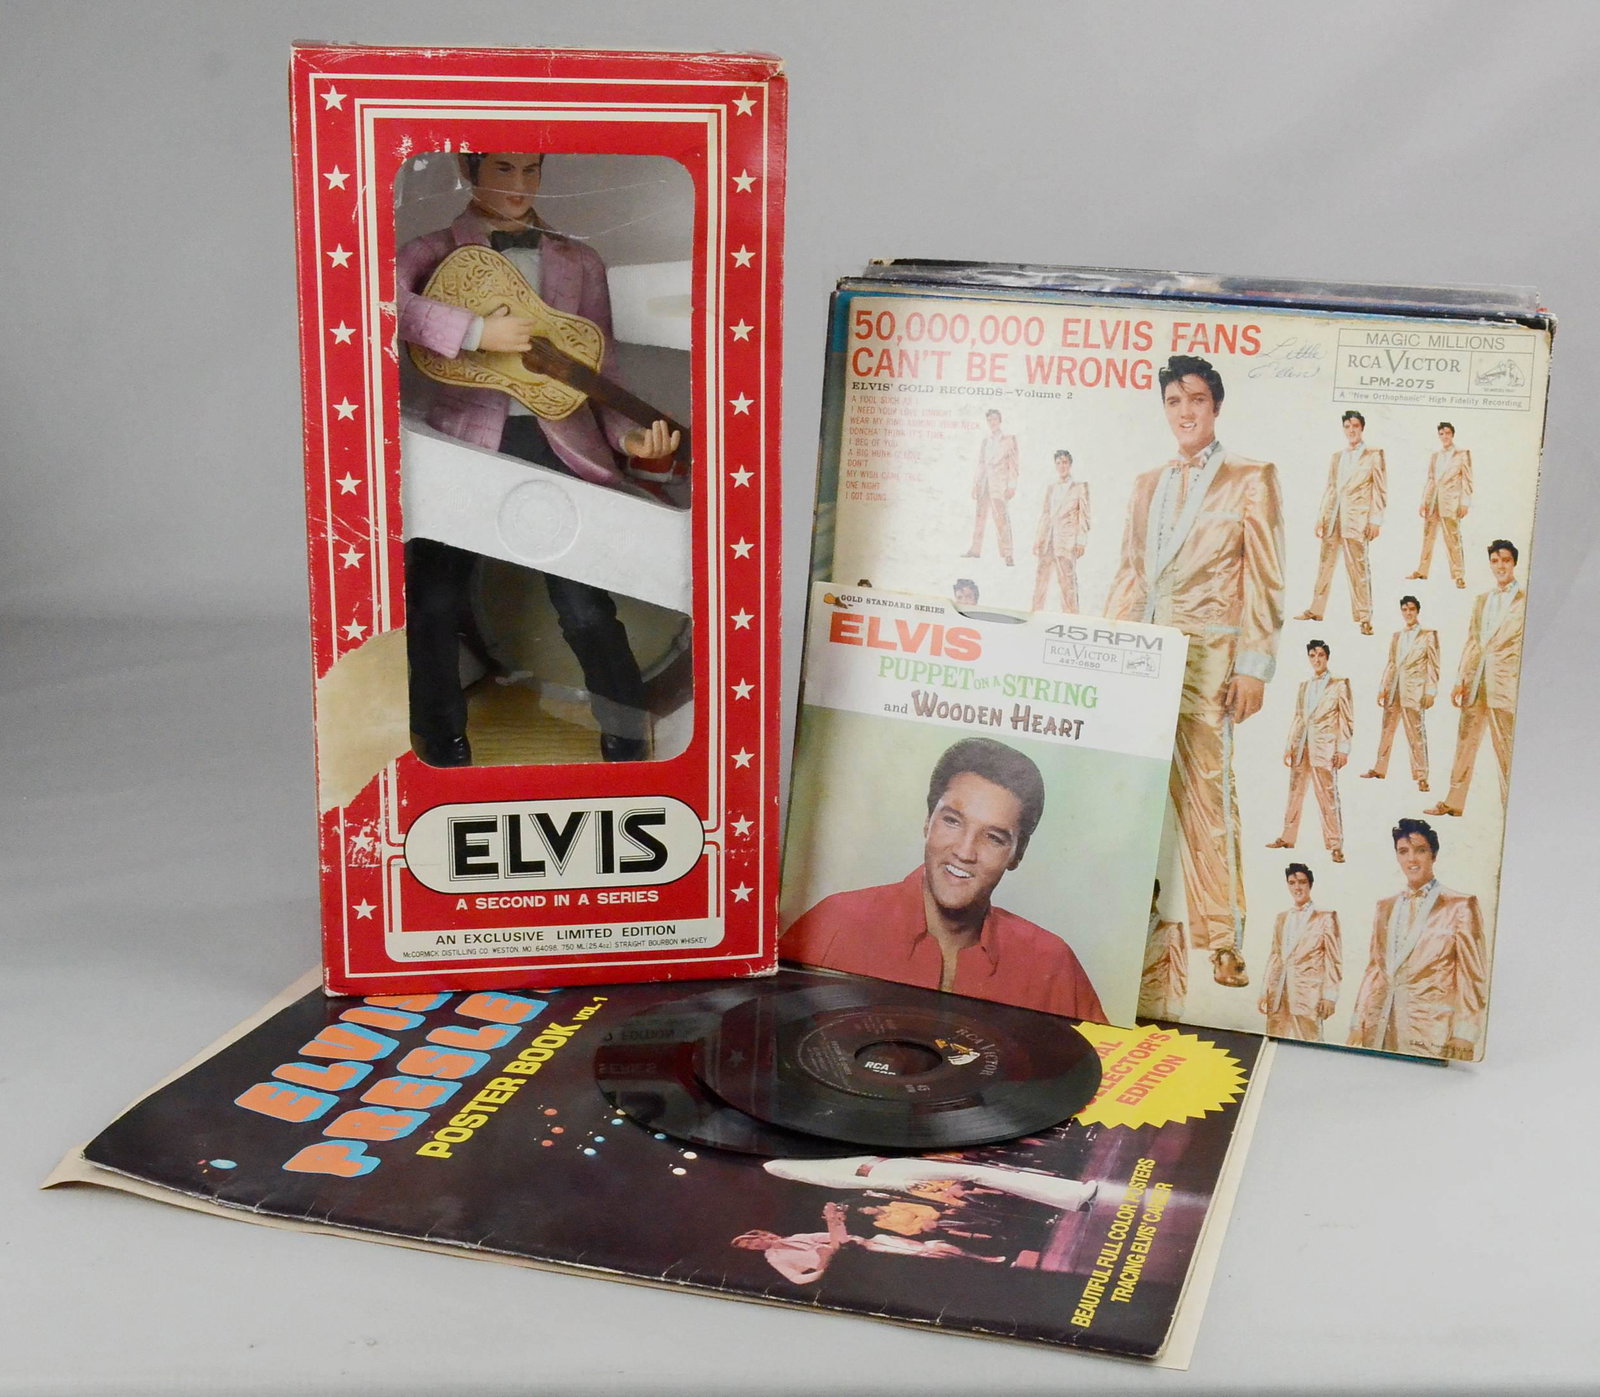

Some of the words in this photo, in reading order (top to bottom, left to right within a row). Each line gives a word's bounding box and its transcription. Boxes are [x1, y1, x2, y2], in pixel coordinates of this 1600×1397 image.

[854, 310, 1044, 347] 50,000,000
[1061, 318, 1154, 351] ELVIS
[1170, 322, 1262, 356] FANS
[1366, 332, 1420, 347] MAGIC
[1428, 334, 1505, 350] MILLIONS
[852, 347, 954, 380] CAN'T
[966, 351, 1008, 383] BE
[1025, 354, 1153, 390] WRONG
[1348, 354, 1381, 369] RCA
[1383, 349, 1462, 374] VICTOR
[852, 382, 894, 392] ELVIS'
[898, 383, 934, 393] GOLD
[1360, 376, 1434, 390] LPM-2075
[857, 406, 875, 414] NEED
[1429, 396, 1447, 404] High
[1450, 397, 1479, 406] Fidelity
[1483, 398, 1522, 408] Recording
[873, 417, 882, 425] MY
[855, 438, 869, 446] BEG
[847, 459, 868, 467] DON'T
[856, 449, 868, 457] BIG
[871, 450, 891, 458] HUNK
[847, 469, 857, 477] MY
[860, 470, 878, 478] WISH
[846, 481, 858, 489] ONE
[862, 482, 880, 490] NIGHT
[851, 492, 863, 500] GOT
[840, 594, 863, 603] GOLD
[866, 597, 912, 609] STANDARD
[914, 604, 945, 614] SERIES
[829, 611, 982, 662] ELVIS
[1045, 624, 1088, 641] 45
[1093, 629, 1163, 651] RPM
[1050, 646, 1071, 656] RCA
[1073, 645, 1118, 663] VICTOR
[878, 655, 975, 690] PUPPET
[974, 676, 989, 690] ON
[990, 676, 1000, 687] A
[1002, 673, 1099, 709] STRING
[884, 702, 908, 714] and
[911, 689, 1003, 727] WOODEN
[1010, 703, 1085, 740] HEART
[447, 807, 669, 882] ELVIS
[456, 898, 468, 911] A
[475, 895, 546, 910] SECOND
[553, 894, 570, 906] IN
[577, 893, 590, 906] A
[597, 890, 659, 905] SERIES
[436, 935, 456, 945] AN
[464, 931, 544, 944] EXCLUSIVE
[557, 928, 612, 940] LIMITED
[622, 925, 676, 937] EDITION
[614, 940, 646, 948] STRAIGHT
[648, 938, 678, 947] BOURBON
[680, 936, 708, 945] WHISKEY
[865, 1061, 889, 1070] RCA
[1078, 1033, 1172, 1114] LECTOR'S
[282, 988, 562, 1178] PRESLE
[416, 1076, 527, 1159] POSTER
[502, 1022, 583, 1075] BOOK
[1116, 1054, 1187, 1106] EDITION
[1123, 1157, 1156, 1204] POSTERS
[1108, 1203, 1138, 1241] COLOR
[1096, 1241, 1123, 1268] FULL
[1111, 1253, 1146, 1303] TRACING
[1131, 1221, 1157, 1254] ELVIS'
[1071, 1269, 1111, 1328] BEAUTIFUL
